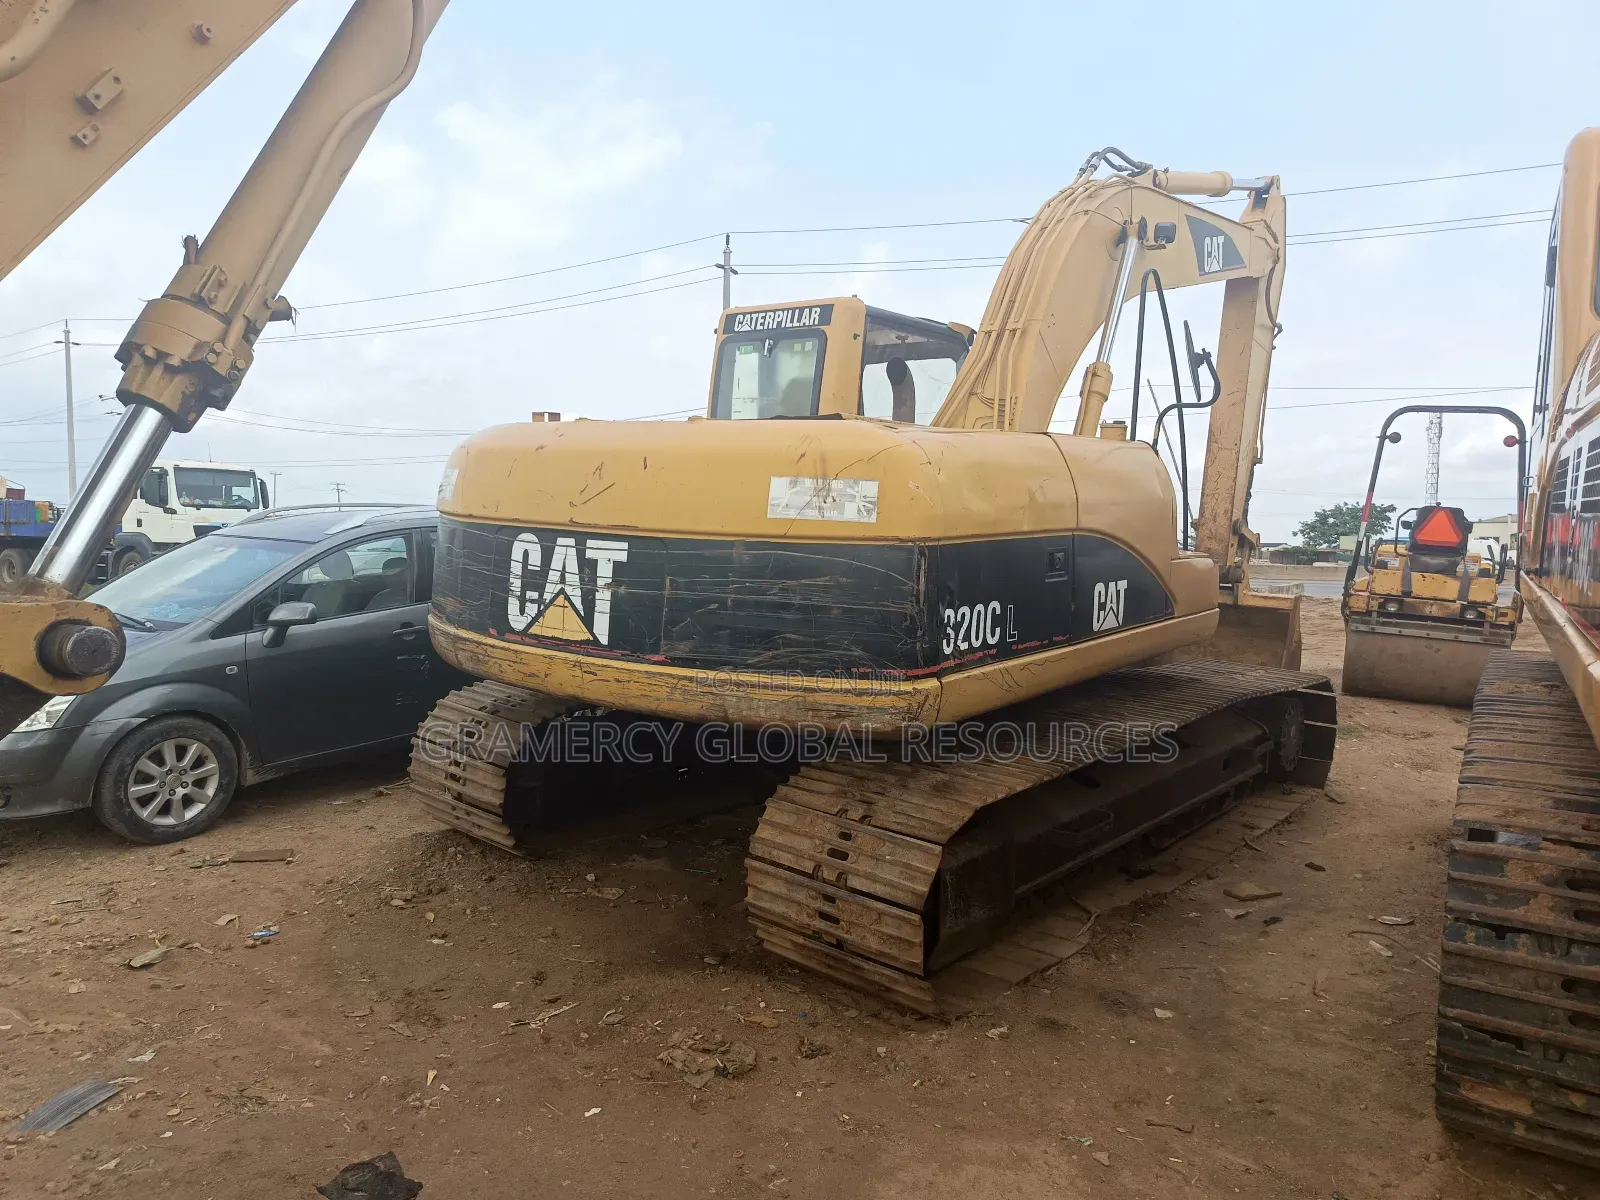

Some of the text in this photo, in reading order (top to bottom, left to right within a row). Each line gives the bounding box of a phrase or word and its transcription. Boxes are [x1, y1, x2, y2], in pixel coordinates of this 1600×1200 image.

[1204, 235, 1225, 273] CAT
[734, 307, 821, 332] CATERPILLAR
[507, 532, 629, 646] CAT
[1092, 579, 1128, 632] CAT
[942, 600, 1001, 655] 320C
